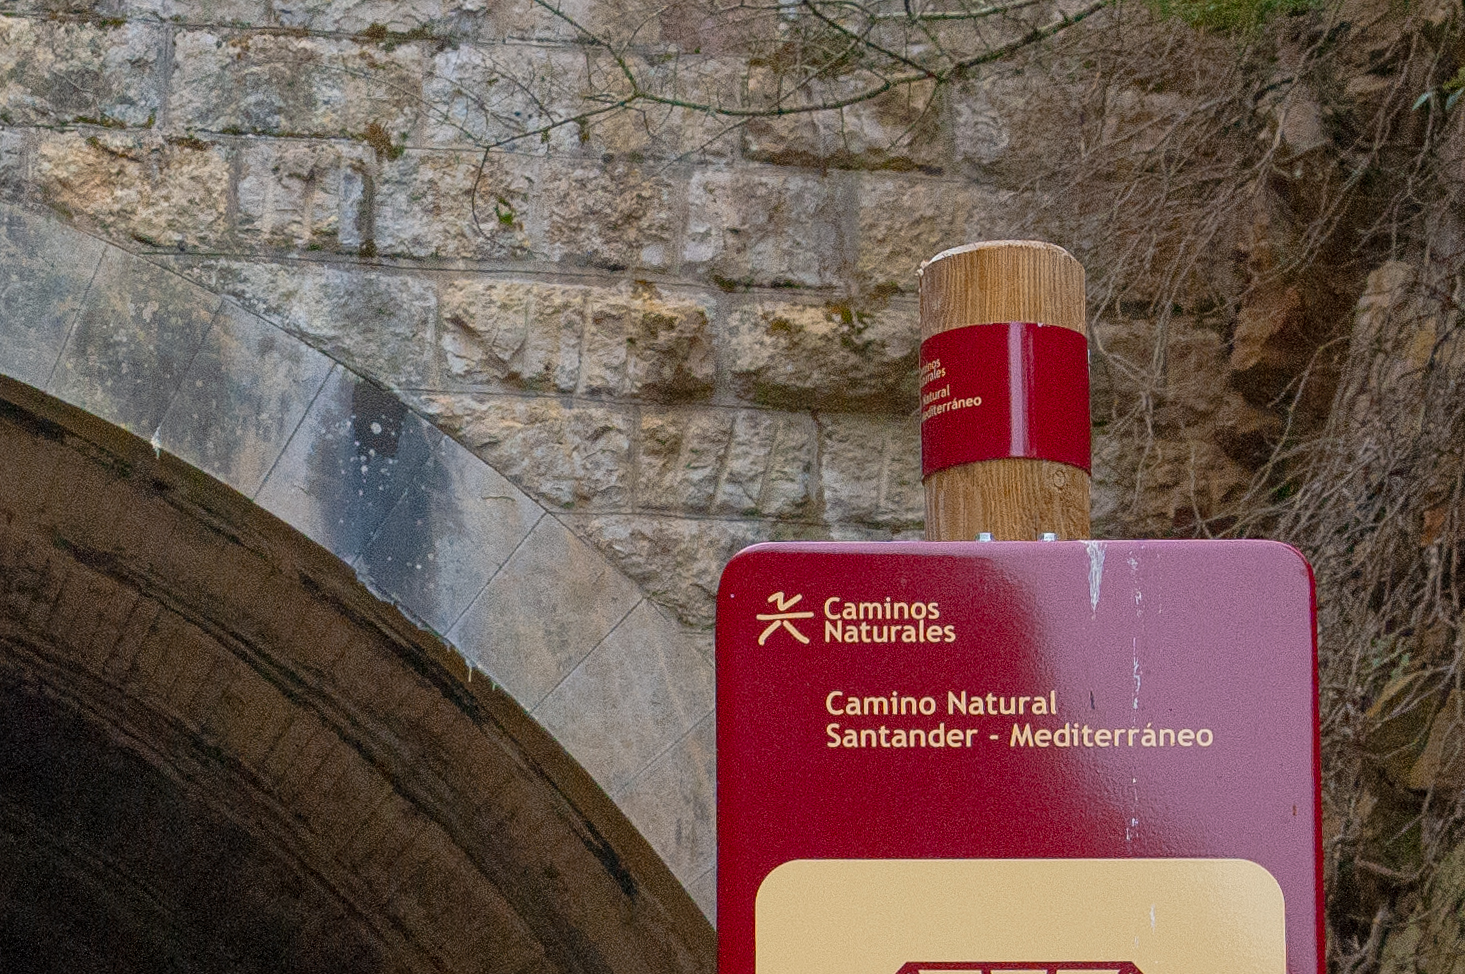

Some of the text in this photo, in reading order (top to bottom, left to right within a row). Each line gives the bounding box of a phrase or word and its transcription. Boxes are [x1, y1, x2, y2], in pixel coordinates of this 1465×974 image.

[825, 597, 940, 620] Caminos
[825, 619, 956, 643] Naturales
[825, 690, 1056, 715] Camino Natural
[826, 722, 978, 748] Santander
[1010, 722, 1213, 748] Mediterráneo
